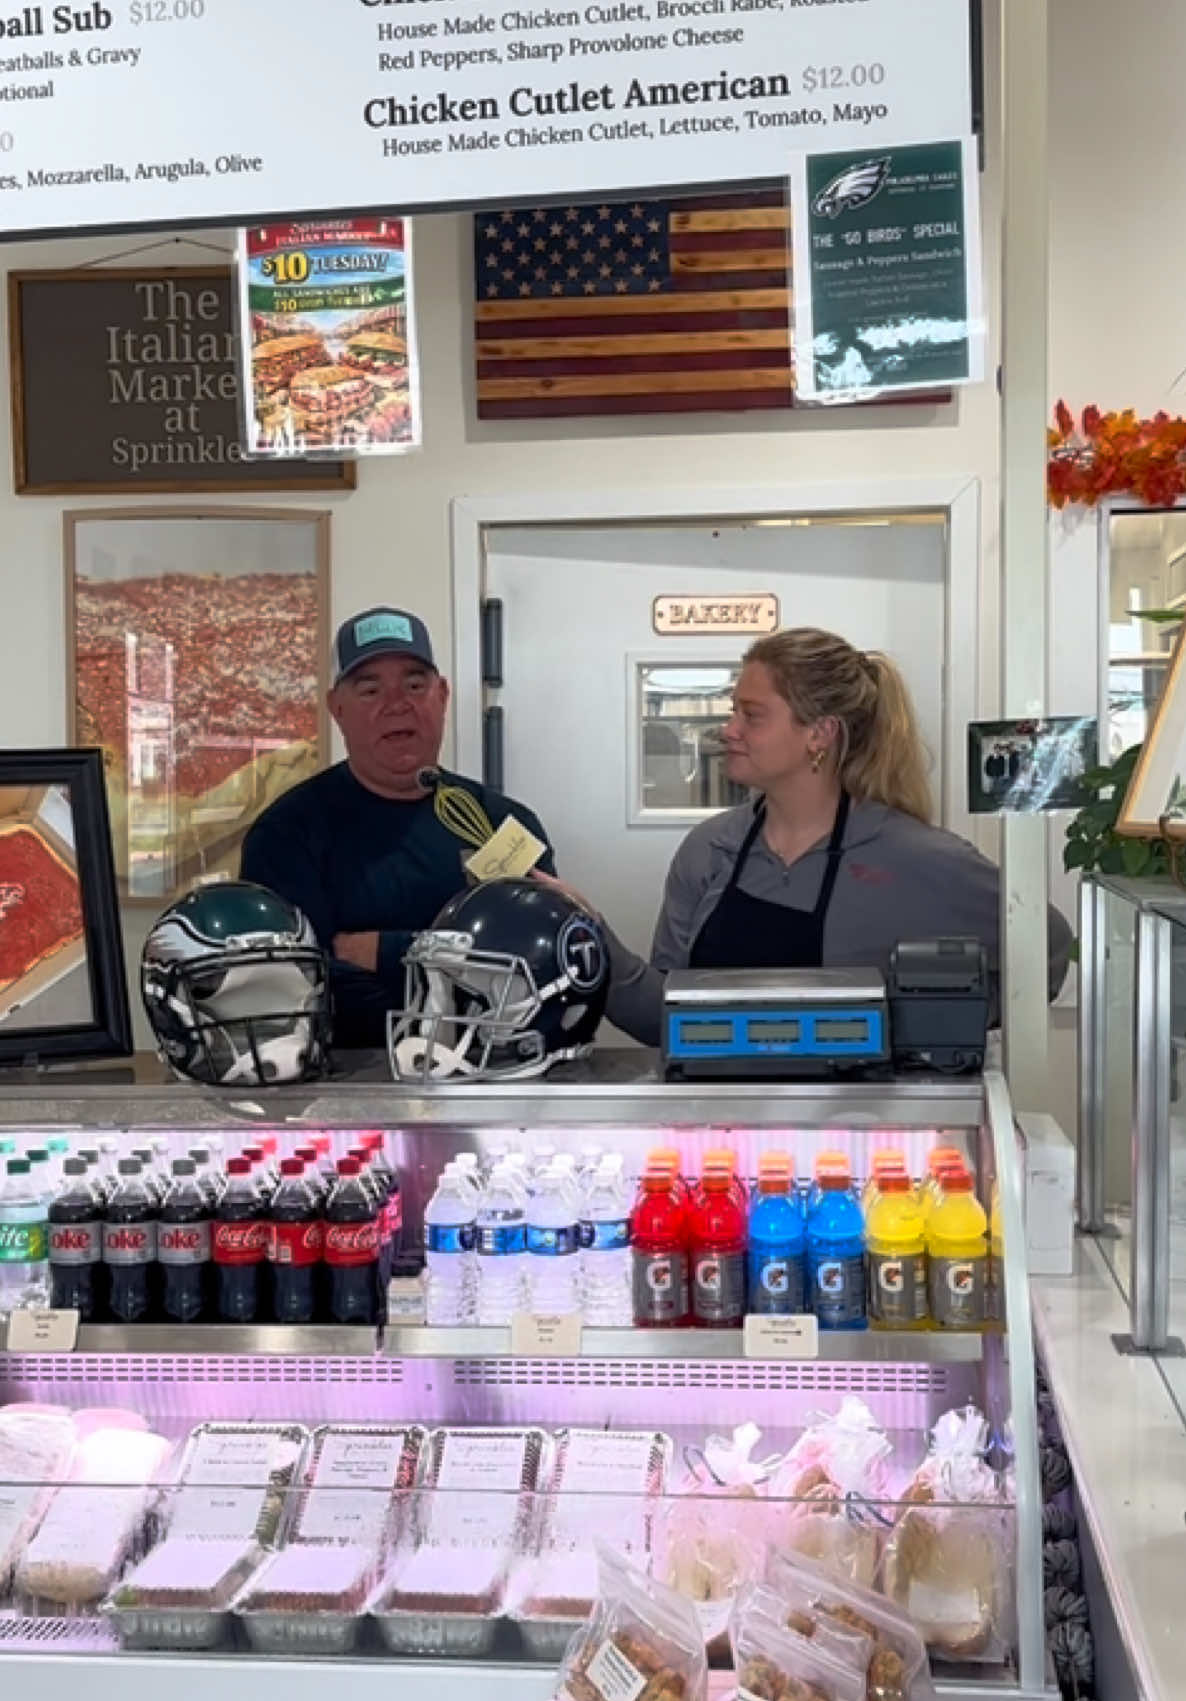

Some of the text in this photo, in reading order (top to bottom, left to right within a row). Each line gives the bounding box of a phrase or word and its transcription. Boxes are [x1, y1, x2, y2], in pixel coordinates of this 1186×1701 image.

[53, 1, 112, 34] Sub
[129, 0, 205, 25] $12.00
[377, 22, 438, 41] House
[443, 16, 496, 35] Made
[501, 8, 580, 31] Chicken
[584, 2, 650, 24] Cutlet,
[68, 48, 82, 66] &
[87, 47, 142, 67] Gravy
[378, 27, 744, 72] Red Peppers, Sharp Provolone Cheese
[363, 63, 885, 128] Chicken Cutlet American $12.00
[382, 103, 888, 157] House Made Chicken Cutlet, Lettuce, Tomato, Mayo
[27, 163, 130, 187] Mozzarella,
[135, 158, 210, 182] Arugula,
[215, 153, 262, 174] Olive
[261, 251, 310, 284] $10
[135, 280, 220, 321] The
[108, 364, 239, 404] Marke
[164, 402, 201, 433] at
[112, 435, 243, 472] Sprinkle
[669, 603, 763, 624] BAKERY
